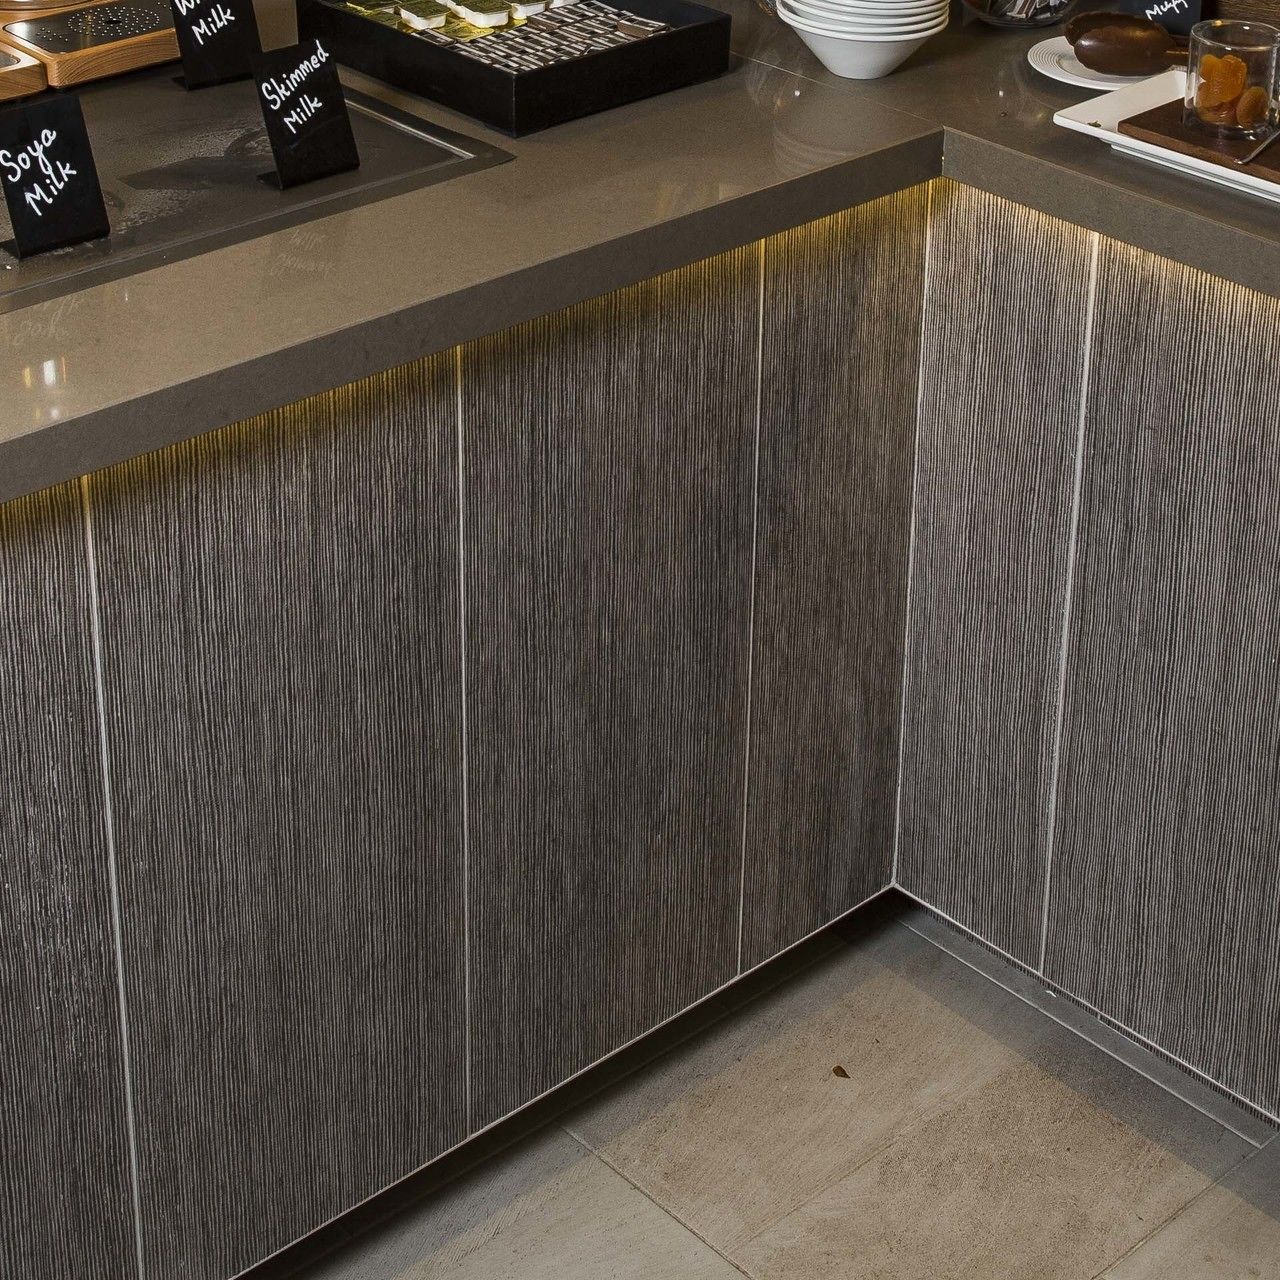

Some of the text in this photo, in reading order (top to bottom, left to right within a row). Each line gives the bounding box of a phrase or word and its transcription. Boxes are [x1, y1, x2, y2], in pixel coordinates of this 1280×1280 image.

[192, 4, 236, 46] Milk
[261, 39, 330, 110] Skimmed
[283, 94, 323, 134] Milk
[24, 160, 77, 216] Milk
